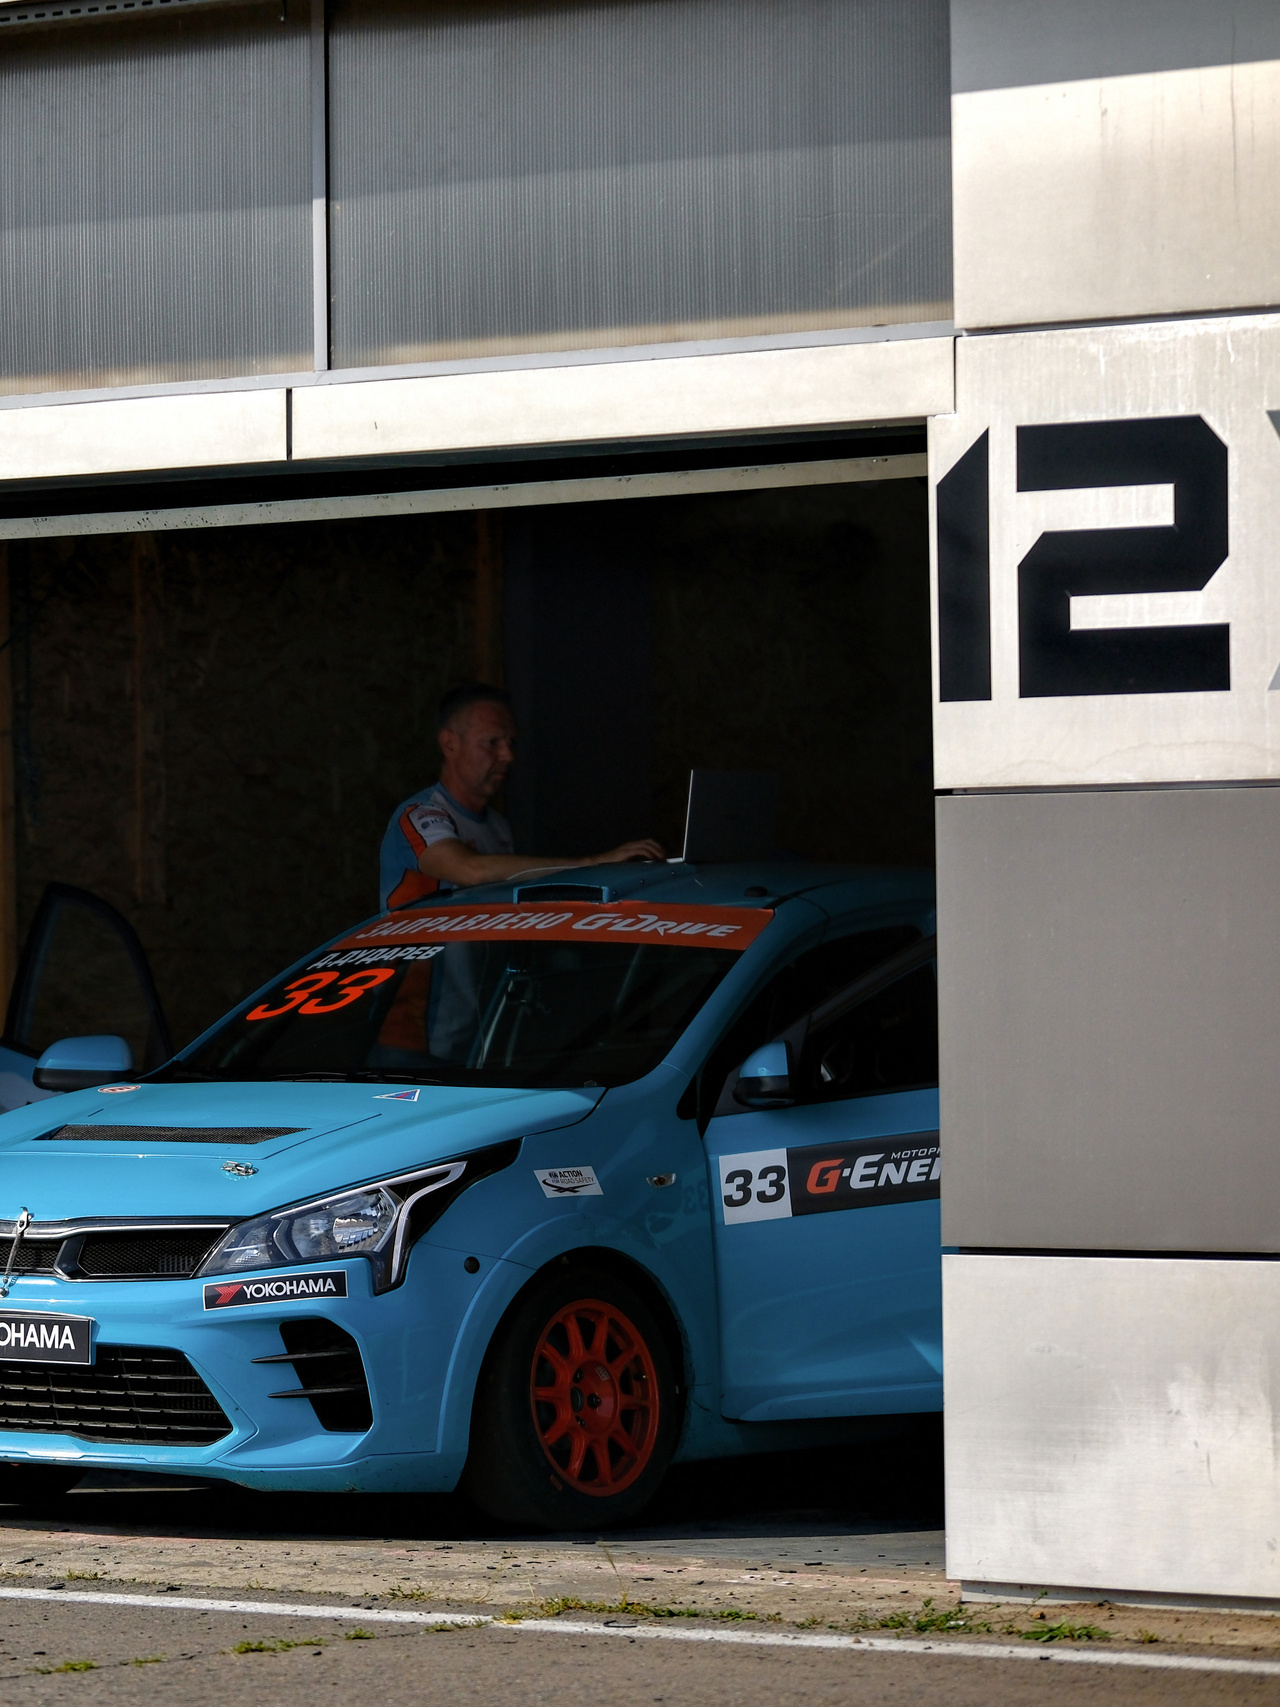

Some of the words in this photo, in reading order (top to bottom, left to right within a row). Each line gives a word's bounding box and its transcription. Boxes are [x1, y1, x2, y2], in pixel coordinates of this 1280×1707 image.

[936, 414, 1231, 703] 12
[356, 912, 574, 939] ЗАПРАВЛЕНО
[246, 968, 395, 1021] 33
[559, 1170, 583, 1178] ACTION
[723, 1165, 787, 1208] 33
[243, 1277, 336, 1299] YOKOHAMA
